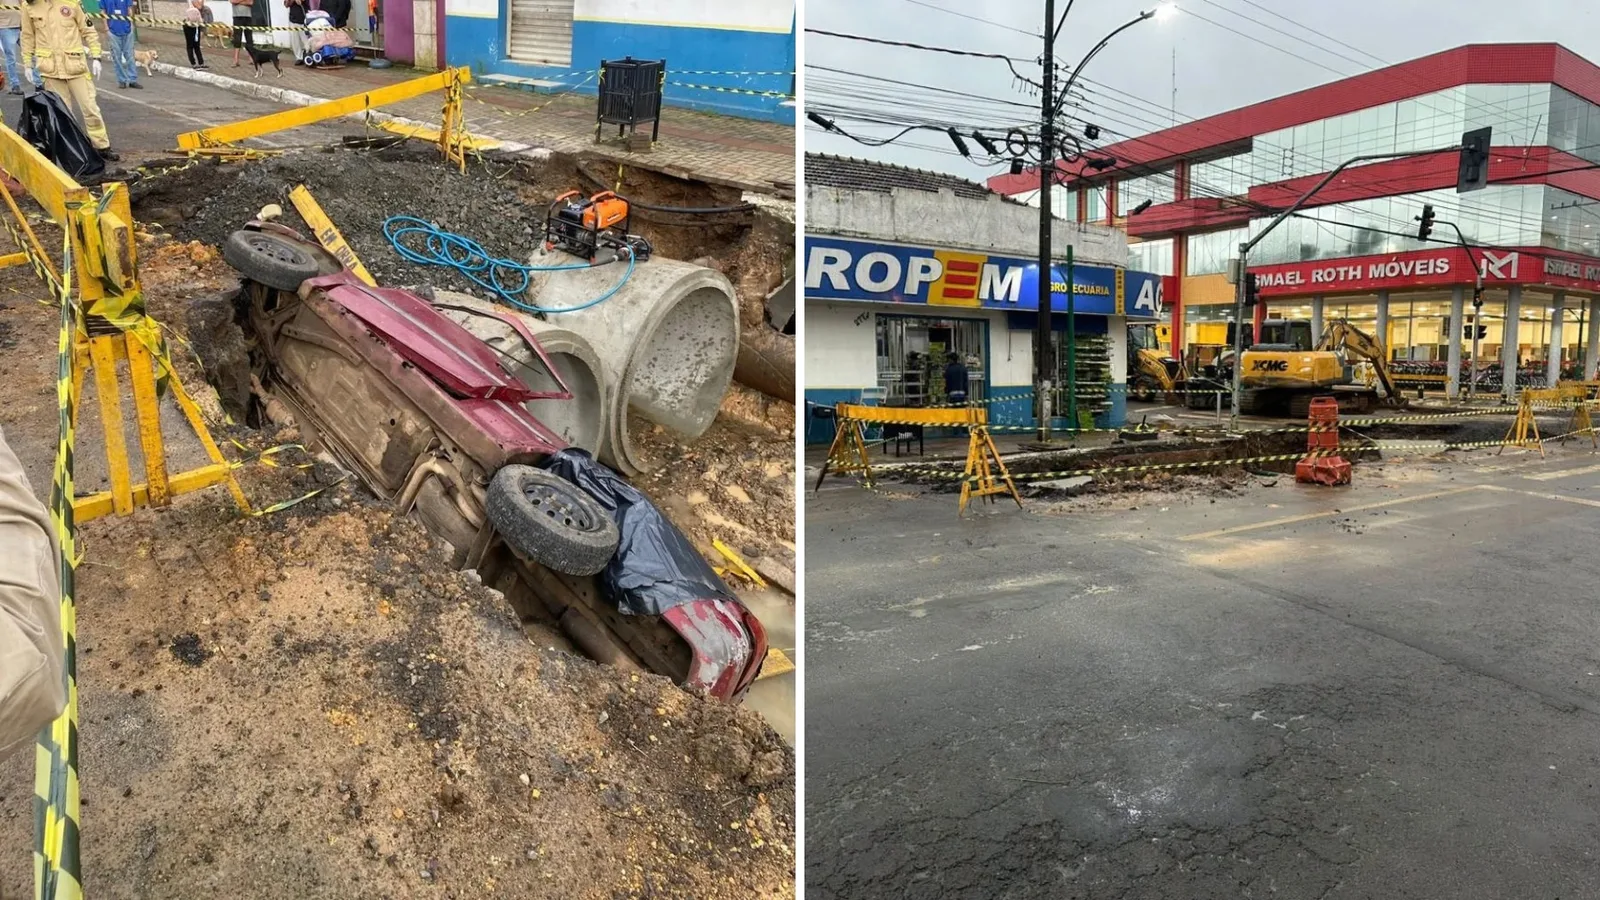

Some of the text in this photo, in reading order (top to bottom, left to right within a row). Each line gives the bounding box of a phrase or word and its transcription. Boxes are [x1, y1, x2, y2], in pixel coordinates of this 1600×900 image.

[804, 246, 1024, 302] ROPEM
[1254, 256, 1450, 287] SMAEL ROTH MÓVEIS
[1050, 281, 1110, 296] GROECUÁRIA
[1251, 360, 1289, 372] XCMG
